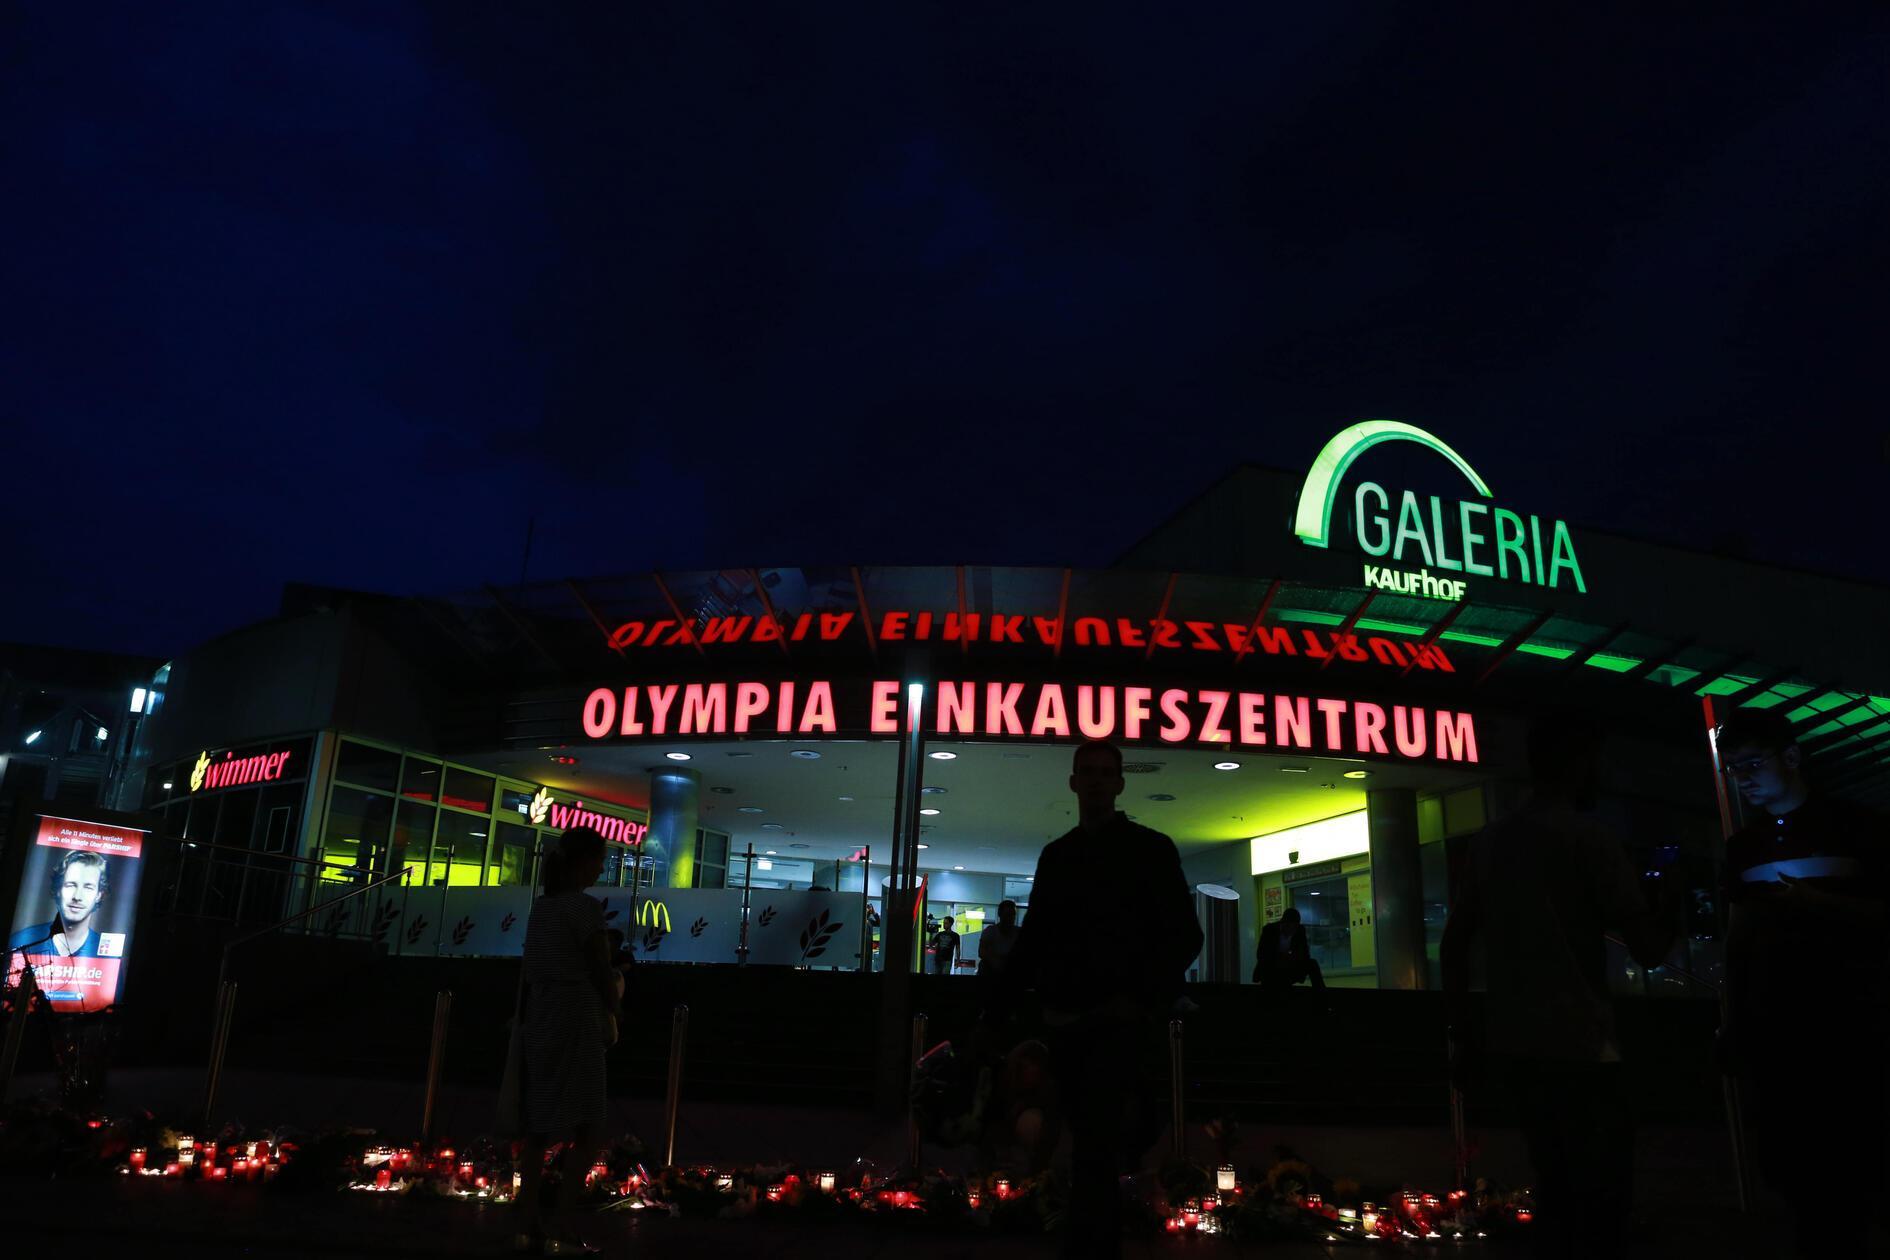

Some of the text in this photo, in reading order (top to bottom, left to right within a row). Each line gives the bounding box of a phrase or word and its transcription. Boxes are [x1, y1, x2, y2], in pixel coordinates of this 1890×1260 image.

[1355, 482, 1586, 593] GALERIA
[583, 681, 837, 738] OLYMPIA
[202, 751, 291, 790] wimmer
[71, 838, 89, 846] Single
[79, 832, 102, 840] Minuten
[102, 835, 123, 843] verliebt
[551, 801, 649, 845] wimmer
